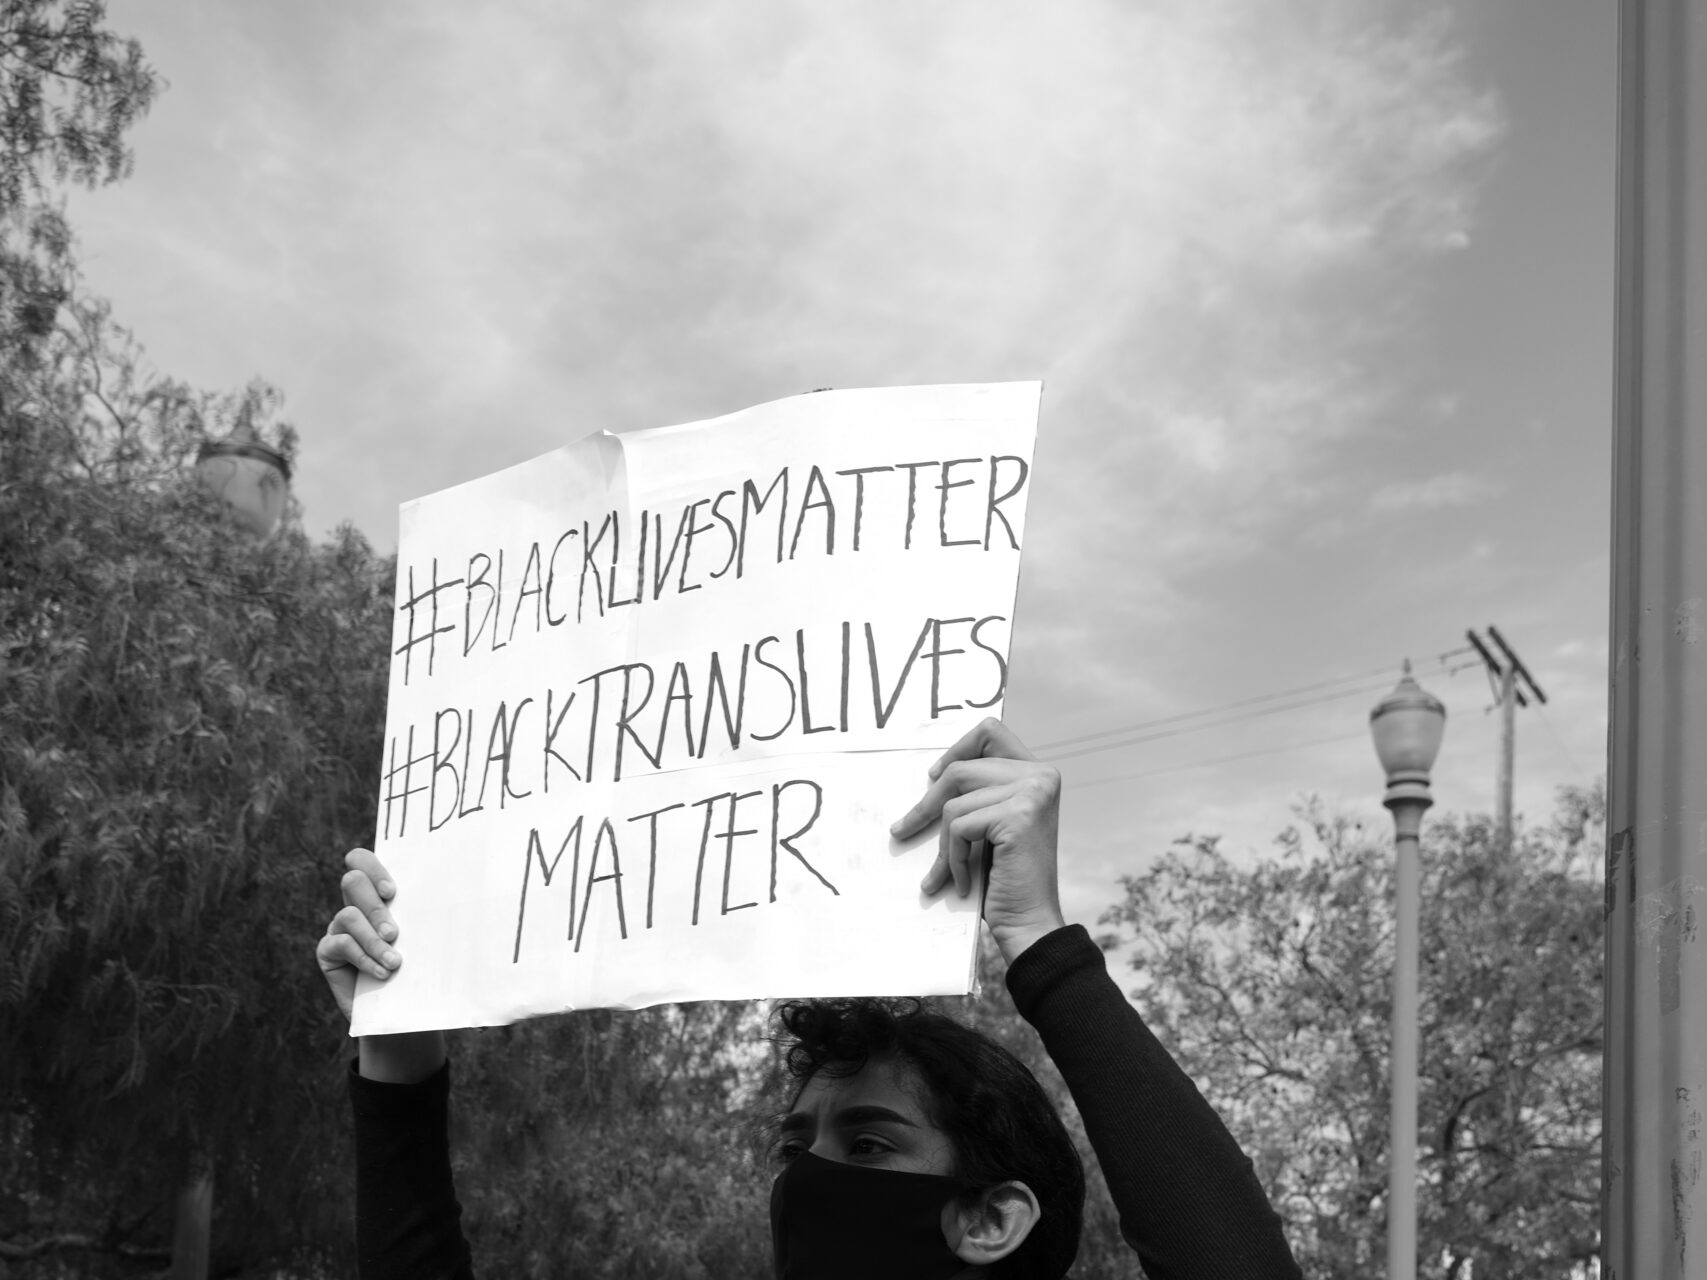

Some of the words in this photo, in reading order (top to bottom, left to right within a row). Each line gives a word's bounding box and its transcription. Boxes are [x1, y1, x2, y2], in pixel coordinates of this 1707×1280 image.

[393, 454, 1029, 686] #BLACKLIVESMATTER
[383, 615, 1008, 840] #BLACKTRANSLIVES
[513, 779, 841, 964] MATTER
